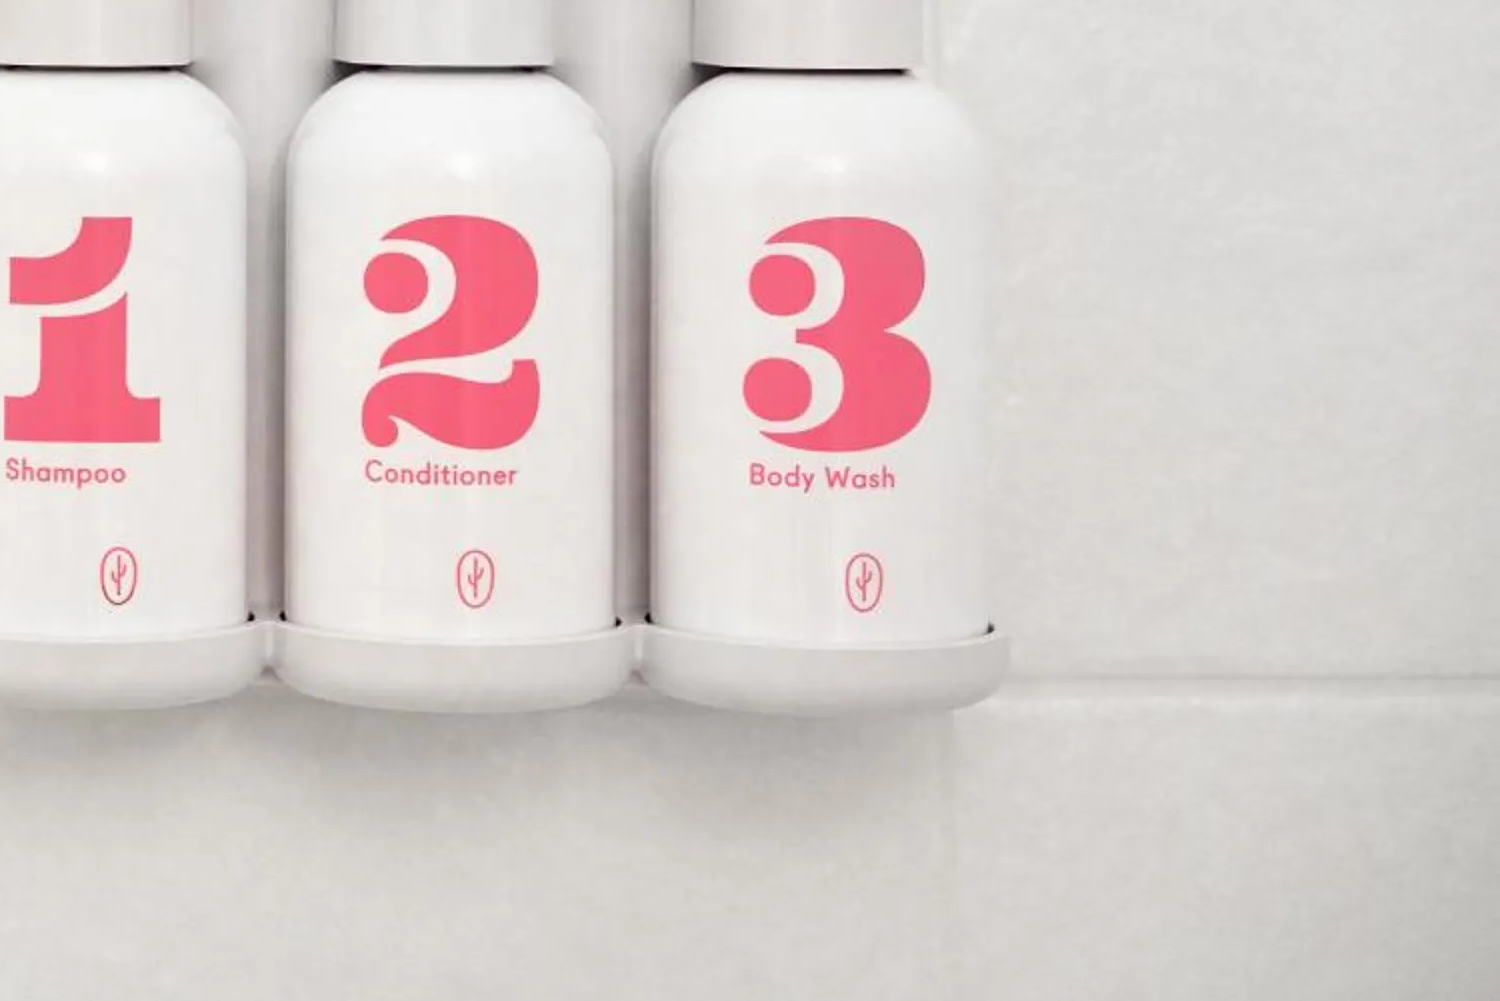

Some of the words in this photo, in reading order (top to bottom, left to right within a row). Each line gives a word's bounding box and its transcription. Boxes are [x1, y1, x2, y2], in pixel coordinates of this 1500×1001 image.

[3, 216, 162, 444] 1
[361, 214, 541, 451] 2
[742, 216, 932, 453] 3
[5, 457, 127, 489] Shampoo
[363, 458, 519, 488] Conditioner
[748, 462, 815, 493] Body
[824, 465, 896, 489] Wash
